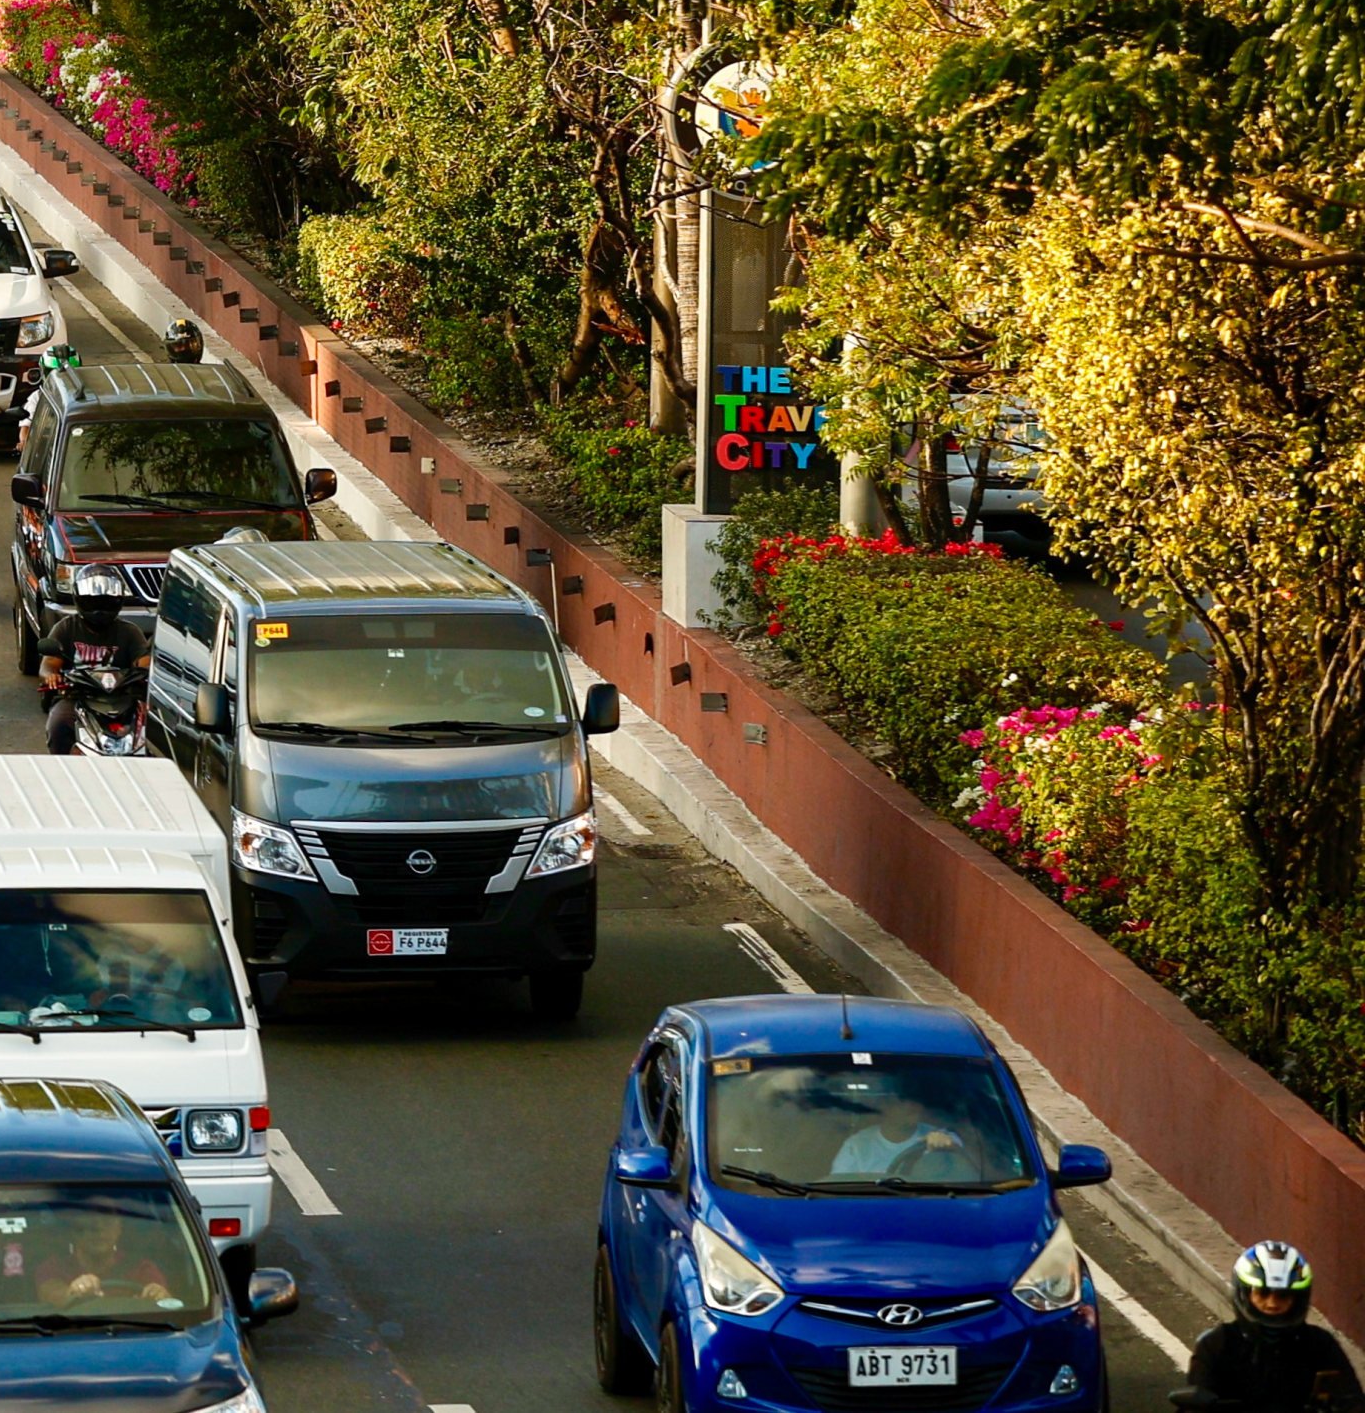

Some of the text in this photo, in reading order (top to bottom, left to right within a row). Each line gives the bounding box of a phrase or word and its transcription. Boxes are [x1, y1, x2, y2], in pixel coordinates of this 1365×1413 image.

[717, 364, 792, 394] THE
[715, 433, 817, 471] CITY
[399, 937, 414, 948] F6
[417, 937, 447, 948] P644
[855, 1353, 951, 1378] ABT 9731
